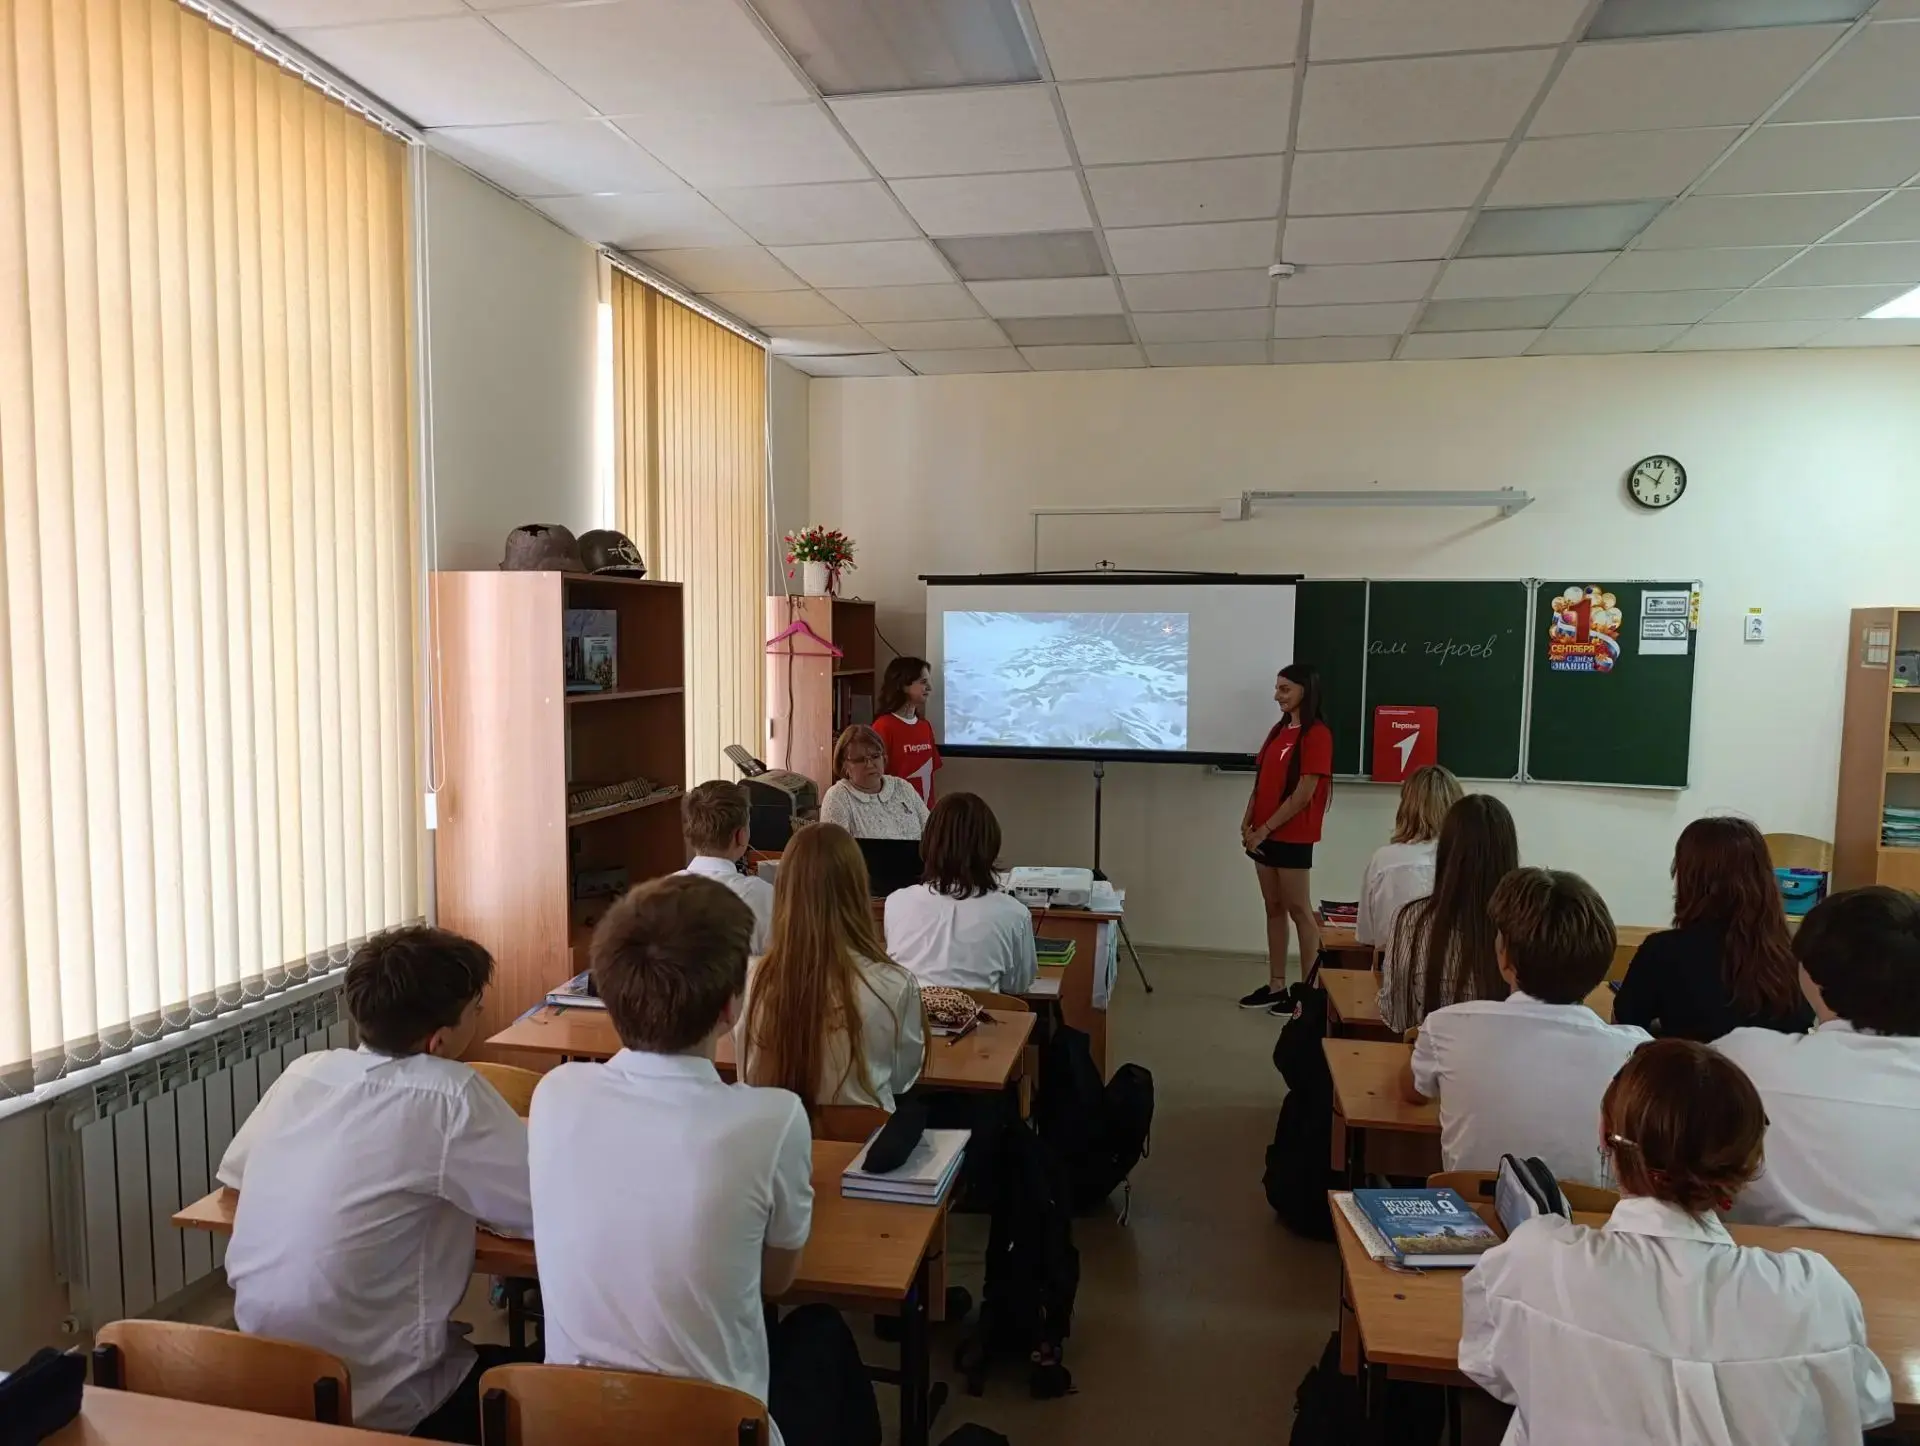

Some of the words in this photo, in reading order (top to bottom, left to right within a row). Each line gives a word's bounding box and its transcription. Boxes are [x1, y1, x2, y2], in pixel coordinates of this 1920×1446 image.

[1653, 460, 1663, 469] 12
[1634, 478, 1640, 487] 9
[1674, 477, 1680, 486] 3
[1654, 494, 1660, 503] 6
[1568, 598, 1592, 644] 1
[1366, 640, 1408, 654] ам
[1551, 644, 1595, 653] СЕНТЯБРЯ
[1382, 1200, 1434, 1208] ИСТОРИЯ
[1437, 1200, 1459, 1214] 9
[1387, 1206, 1440, 1215] РОССИИ
